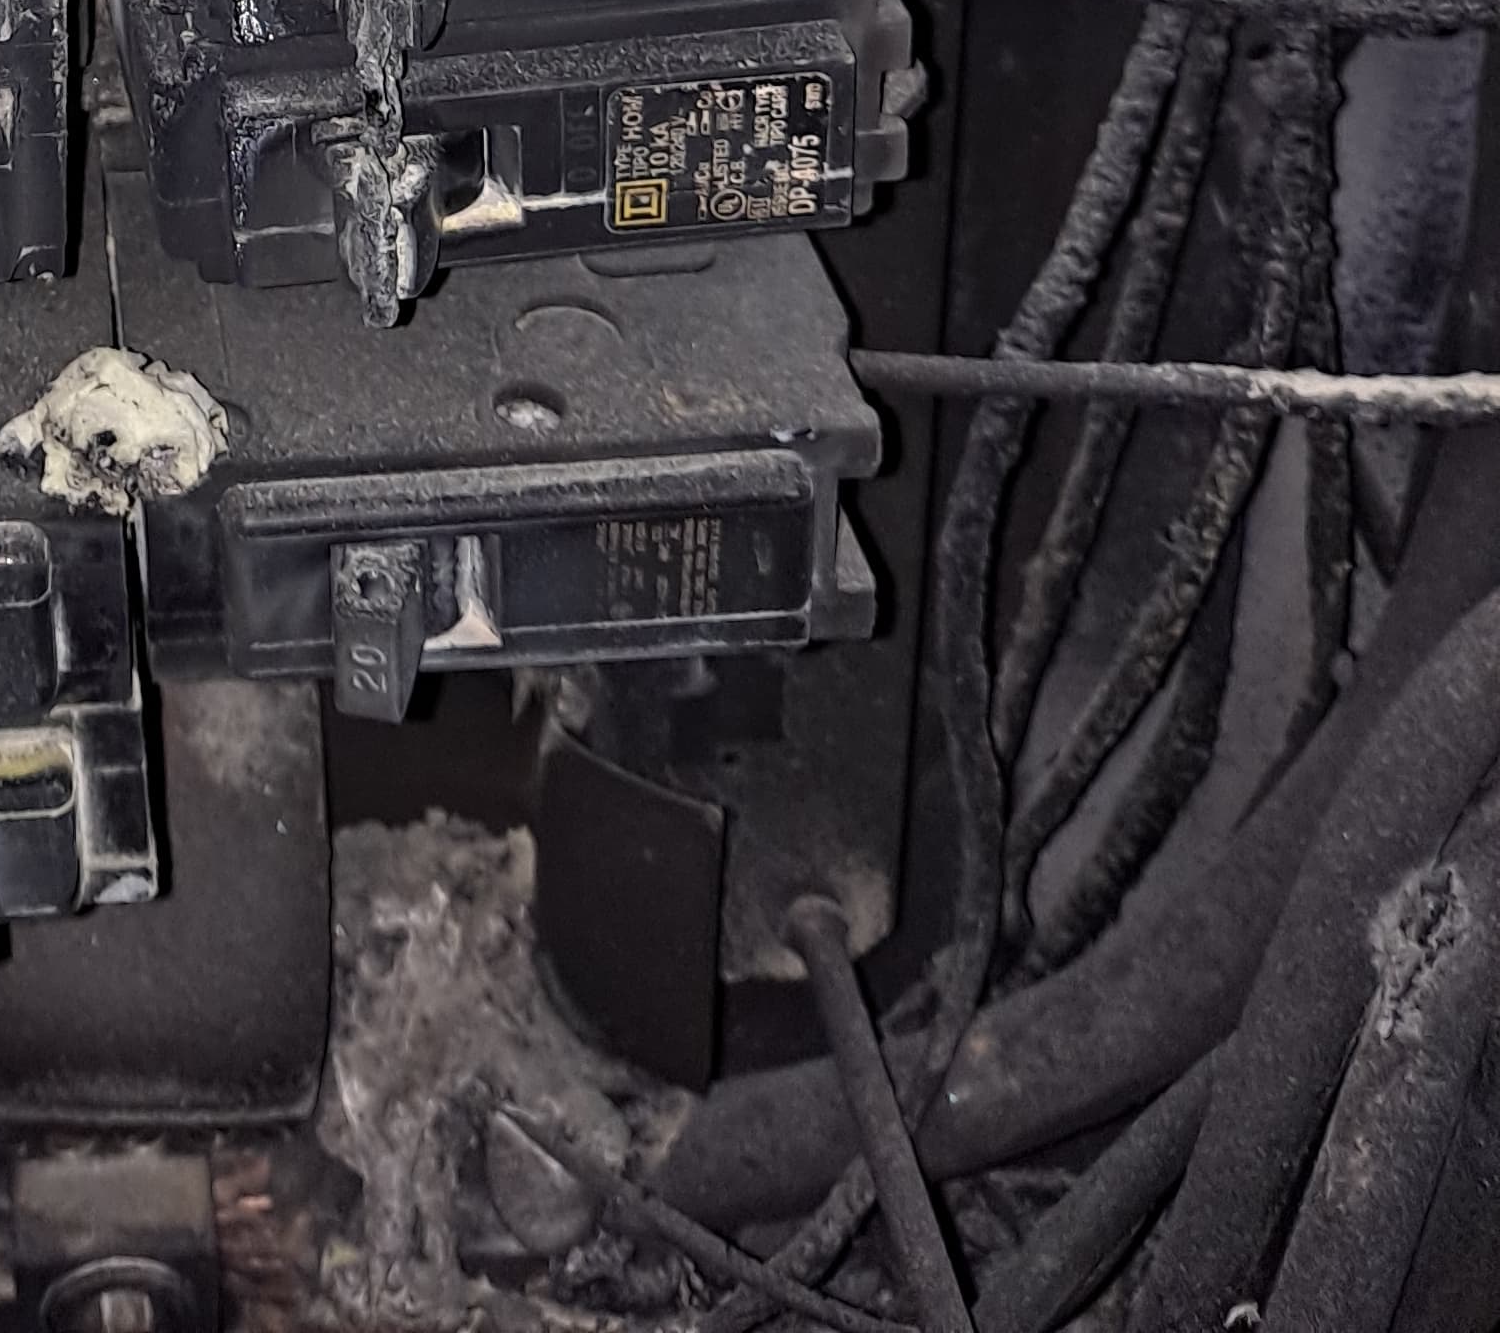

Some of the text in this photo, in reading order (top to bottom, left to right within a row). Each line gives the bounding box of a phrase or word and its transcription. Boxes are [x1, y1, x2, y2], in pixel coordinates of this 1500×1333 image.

[622, 95, 643, 140] HOM
[615, 143, 631, 179] TYPE
[633, 146, 649, 177] TIPO
[650, 152, 669, 176] 10
[713, 139, 730, 185] LISTED
[350, 644, 388, 694] 20
